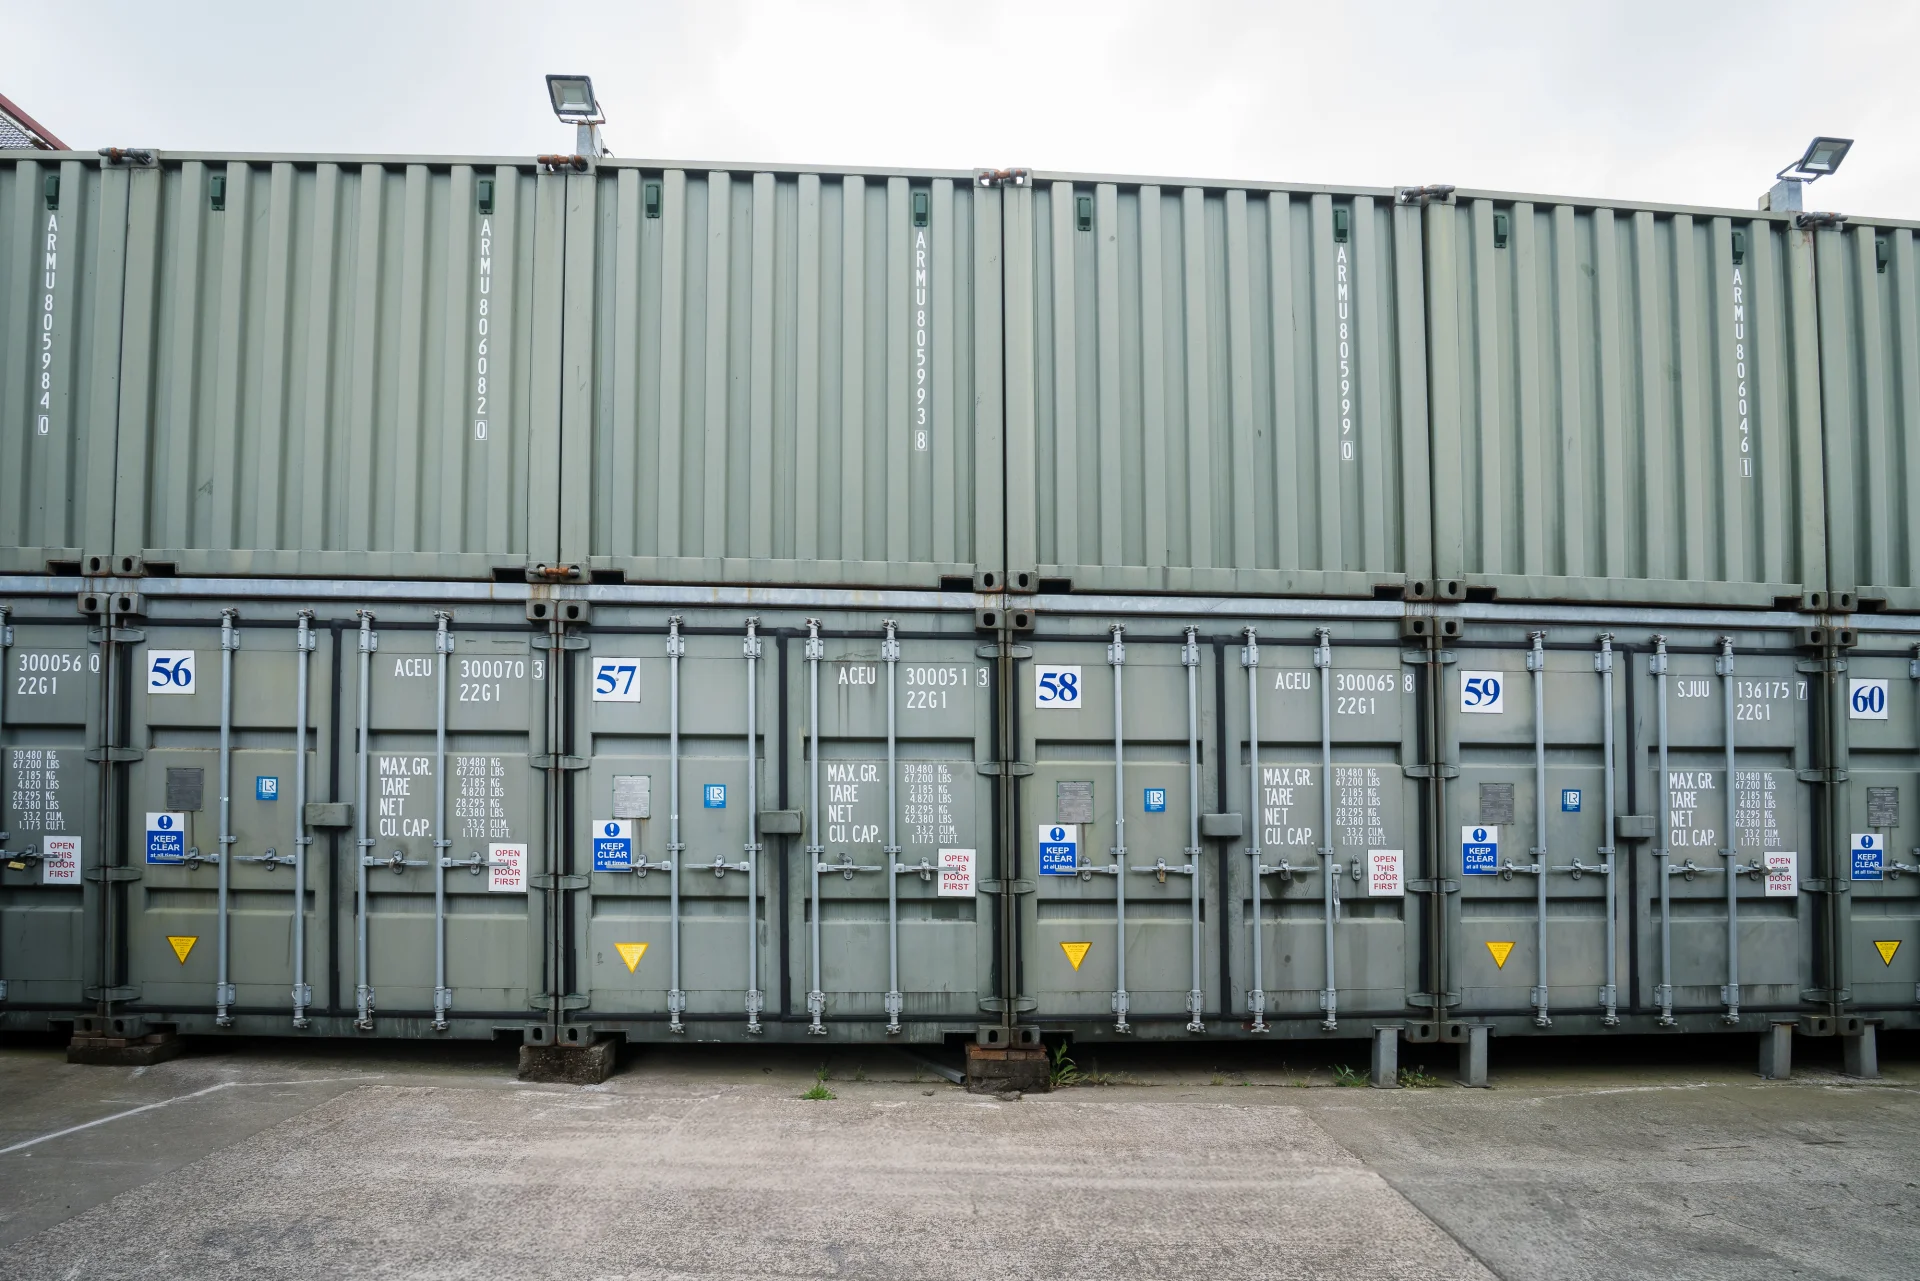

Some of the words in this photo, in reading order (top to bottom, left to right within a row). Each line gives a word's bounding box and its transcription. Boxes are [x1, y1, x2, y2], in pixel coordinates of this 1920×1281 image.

[20, 654, 81, 671] 300056
[152, 658, 191, 686] 56
[395, 659, 431, 676] ACEU
[461, 660, 523, 678] 300070
[597, 666, 636, 694] 57
[839, 667, 875, 684] ACEU
[907, 668, 966, 685] 300051
[18, 677, 56, 694] 22G1
[1275, 672, 1310, 689] ACEU
[1337, 674, 1394, 691] 300065
[1040, 673, 1077, 700] 58
[1678, 681, 1709, 697] SJUU
[1738, 682, 1789, 698] 136175
[460, 684, 499, 701] 22G1
[1465, 678, 1500, 705] 59
[907, 691, 945, 708] 22G1
[1852, 688, 1884, 712] 60
[1338, 697, 1374, 714] 22G1
[1737, 704, 1769, 720] 22G1
[14, 751, 41, 759] 30.480
[47, 751, 55, 759] KG
[13, 760, 41, 768] 67.200
[47, 760, 59, 768] LBS
[457, 757, 485, 766] 30.480
[491, 758, 500, 766] KG
[457, 767, 485, 776] 67.200
[491, 767, 504, 776] LBS
[905, 765, 932, 773] 30.480
[938, 765, 947, 773] KG
[1336, 768, 1362, 777] 30.480
[1368, 768, 1376, 777] KG
[18, 771, 40, 779] 2.185
[46, 771, 55, 779] KG
[905, 774, 932, 782] 67.200
[939, 774, 951, 782] LBS
[1736, 772, 1760, 780] 30.480
[1764, 773, 1772, 781] KG
[18, 780, 40, 789] 4.820
[46, 780, 59, 789] LBS
[462, 778, 485, 788] 2.185
[491, 778, 499, 787] KG
[1336, 777, 1362, 786] 67.200
[1368, 777, 1380, 786] LBS
[1736, 781, 1760, 789] 67.200
[1765, 780, 1775, 789] LBS
[381, 778, 410, 795] TARE
[910, 785, 932, 793] 2.185
[939, 785, 947, 793] KG
[13, 791, 40, 800] 28.295
[46, 791, 54, 800] KG
[462, 787, 485, 796] 4.820
[491, 788, 504, 796] LBS
[829, 785, 858, 802] TARE
[1342, 788, 1362, 796] 2.185
[1368, 788, 1376, 796] KG
[1741, 791, 1760, 799] 2.185
[910, 794, 933, 803] 4.820
[939, 794, 951, 803] LBS
[1265, 788, 1293, 805] TARE
[1341, 797, 1363, 805] 4.820
[1368, 797, 1380, 805] LBS
[1671, 792, 1697, 808] TARE
[13, 801, 40, 809] 62.380
[46, 801, 59, 809] LBS
[380, 798, 404, 815] NET
[456, 798, 484, 807] 28.295
[491, 799, 499, 807] KG
[1740, 800, 1760, 808] 4.820
[1765, 800, 1775, 808] LBS
[456, 808, 484, 816] 62.380
[491, 808, 503, 817] LBS
[829, 805, 853, 822] NET
[905, 805, 933, 815] 28.295
[939, 805, 947, 814] KG
[1337, 808, 1362, 816] 28.295
[1368, 808, 1376, 816] KG
[1736, 810, 1759, 818] 28.295
[1765, 810, 1772, 818] KG
[905, 814, 933, 823] 62.380
[939, 814, 952, 823] LBS
[1265, 808, 1288, 825] NET
[1337, 817, 1363, 825] 62.380
[1368, 817, 1380, 825] LBS
[1671, 811, 1692, 827] NET
[380, 819, 399, 836] CU.
[403, 819, 431, 836] CAP.
[1736, 819, 1760, 827] 62.380
[1765, 819, 1775, 827] LBS
[829, 825, 848, 842] CU.
[853, 825, 881, 842] CAP.
[1266, 828, 1283, 844] CU.
[1288, 828, 1314, 844] CAP.
[1672, 830, 1688, 846] CU.
[1693, 830, 1716, 845] CAP.
[50, 842, 75, 850] OPEN
[495, 849, 520, 857] OPEN
